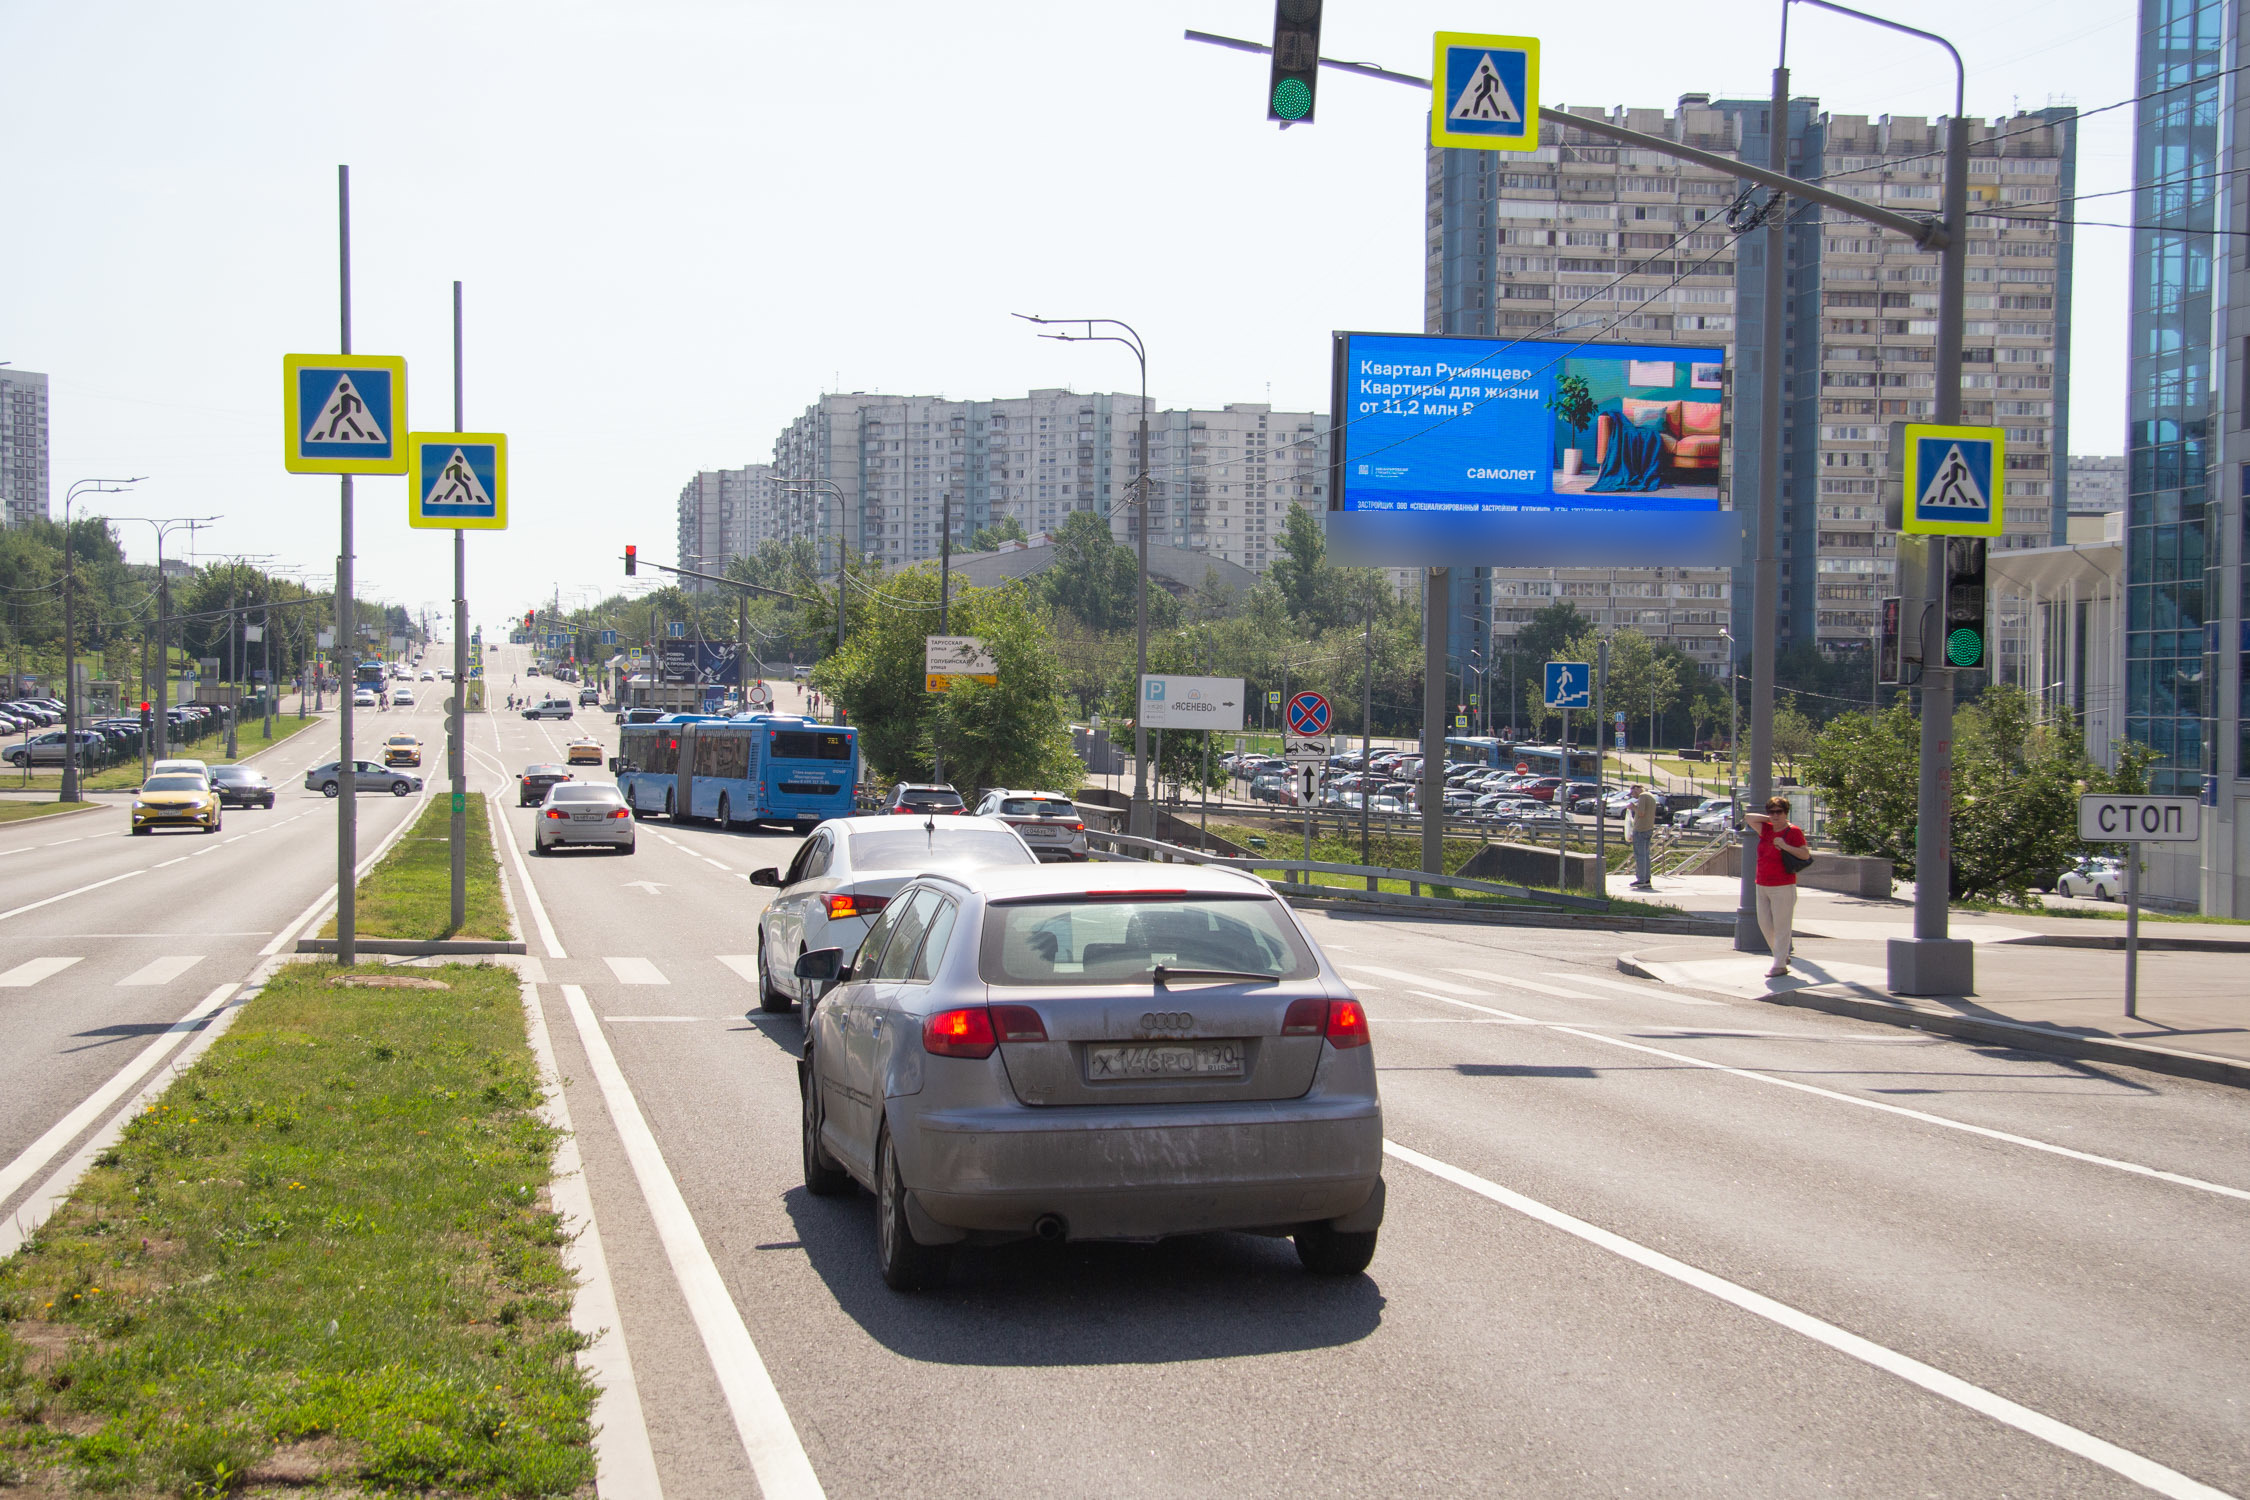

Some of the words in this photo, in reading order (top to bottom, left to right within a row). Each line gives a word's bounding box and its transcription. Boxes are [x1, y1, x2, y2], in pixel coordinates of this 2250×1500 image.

[1361, 360, 1431, 379] Квартал
[1436, 363, 1532, 382] Румянцево
[1360, 379, 1445, 398] Квартиры
[1449, 386, 1480, 399] для
[1484, 387, 1539, 400] жизни
[1359, 402, 1379, 414] от
[1382, 400, 1419, 416] 11,2
[1423, 403, 1458, 416] млн
[1466, 467, 1536, 480] самолет
[1357, 501, 1394, 510] ЗАСТРОЙЩИК
[1171, 702, 1217, 712] «ЯСЕНЕВО»
[2098, 804, 2181, 833] СТОП
